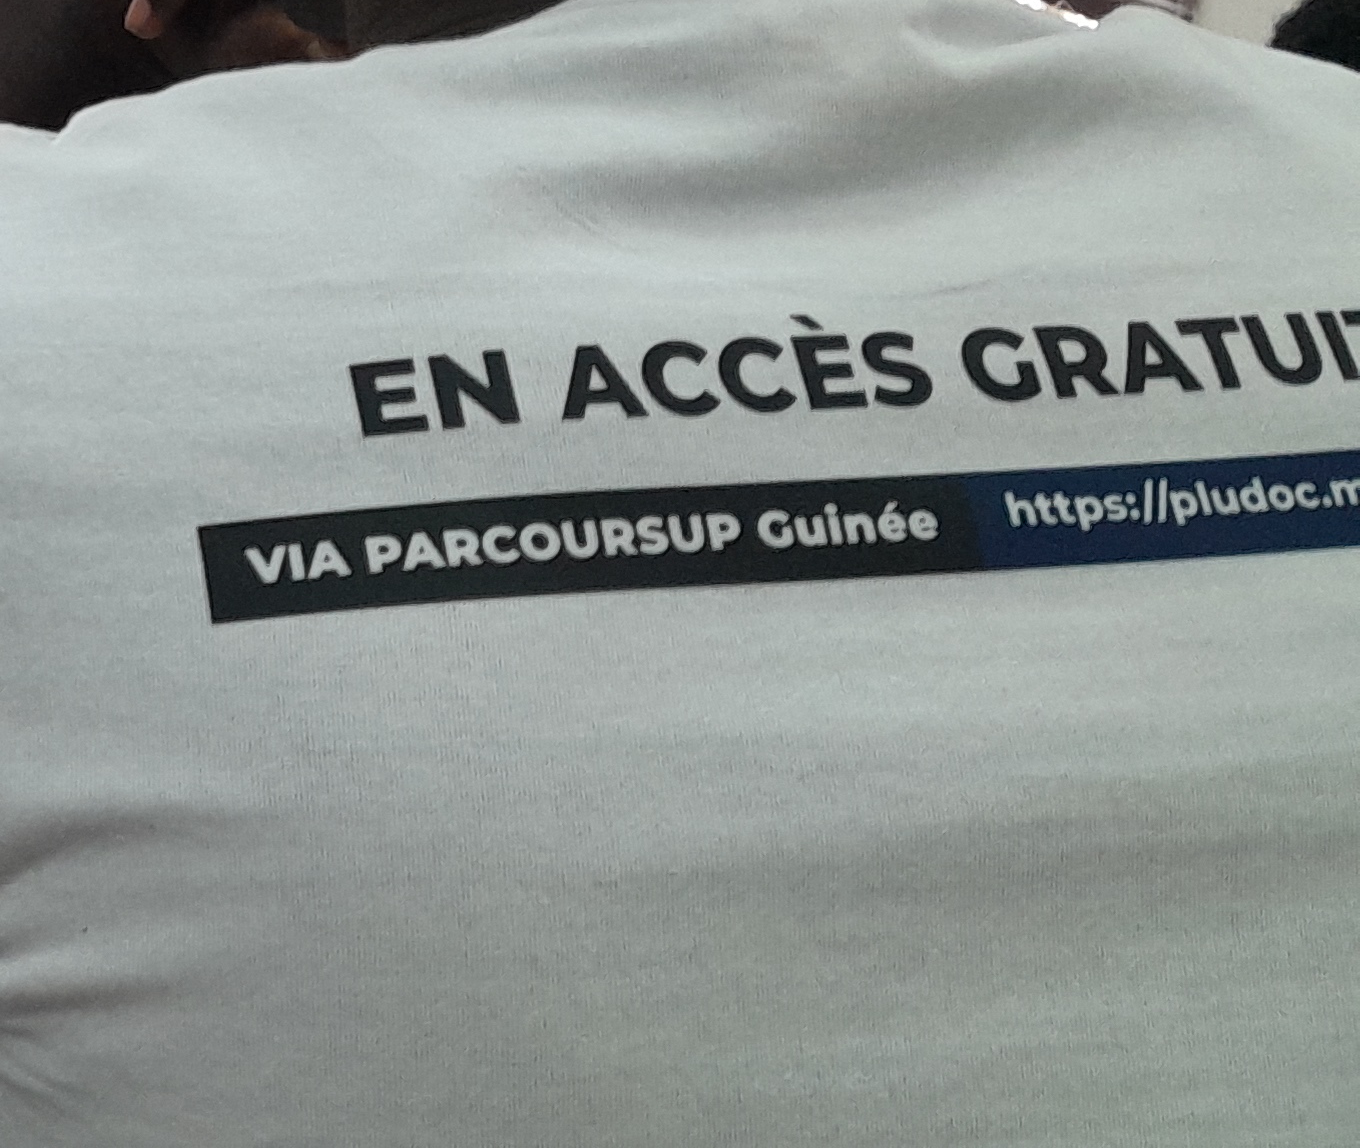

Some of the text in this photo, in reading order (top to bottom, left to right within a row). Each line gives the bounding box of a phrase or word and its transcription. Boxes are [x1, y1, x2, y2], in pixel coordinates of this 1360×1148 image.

[349, 348, 521, 438] EN
[562, 313, 934, 420] ACCÈS
[244, 539, 353, 586] VIA
[363, 511, 742, 575] PARCOURSUP
[756, 500, 941, 550] Guinée
